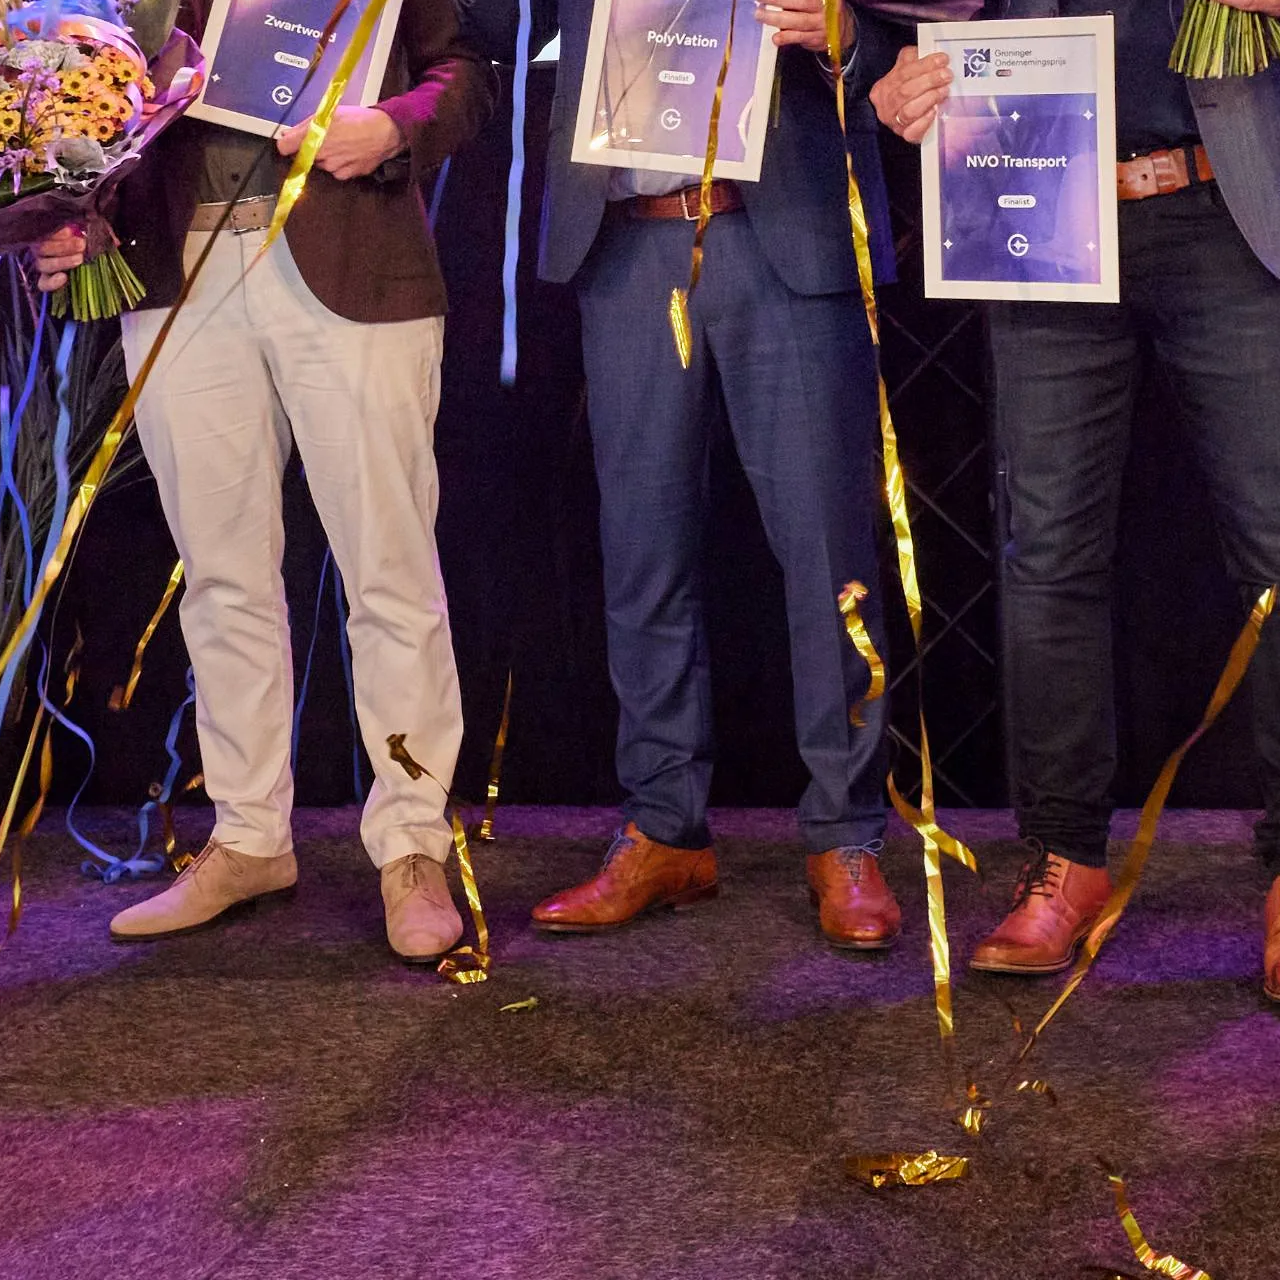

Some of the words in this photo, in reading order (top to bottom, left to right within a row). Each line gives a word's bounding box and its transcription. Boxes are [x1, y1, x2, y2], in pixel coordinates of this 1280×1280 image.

[647, 30, 718, 49] PolyVation
[966, 155, 999, 168] NVO
[1001, 155, 1067, 171] Transport
